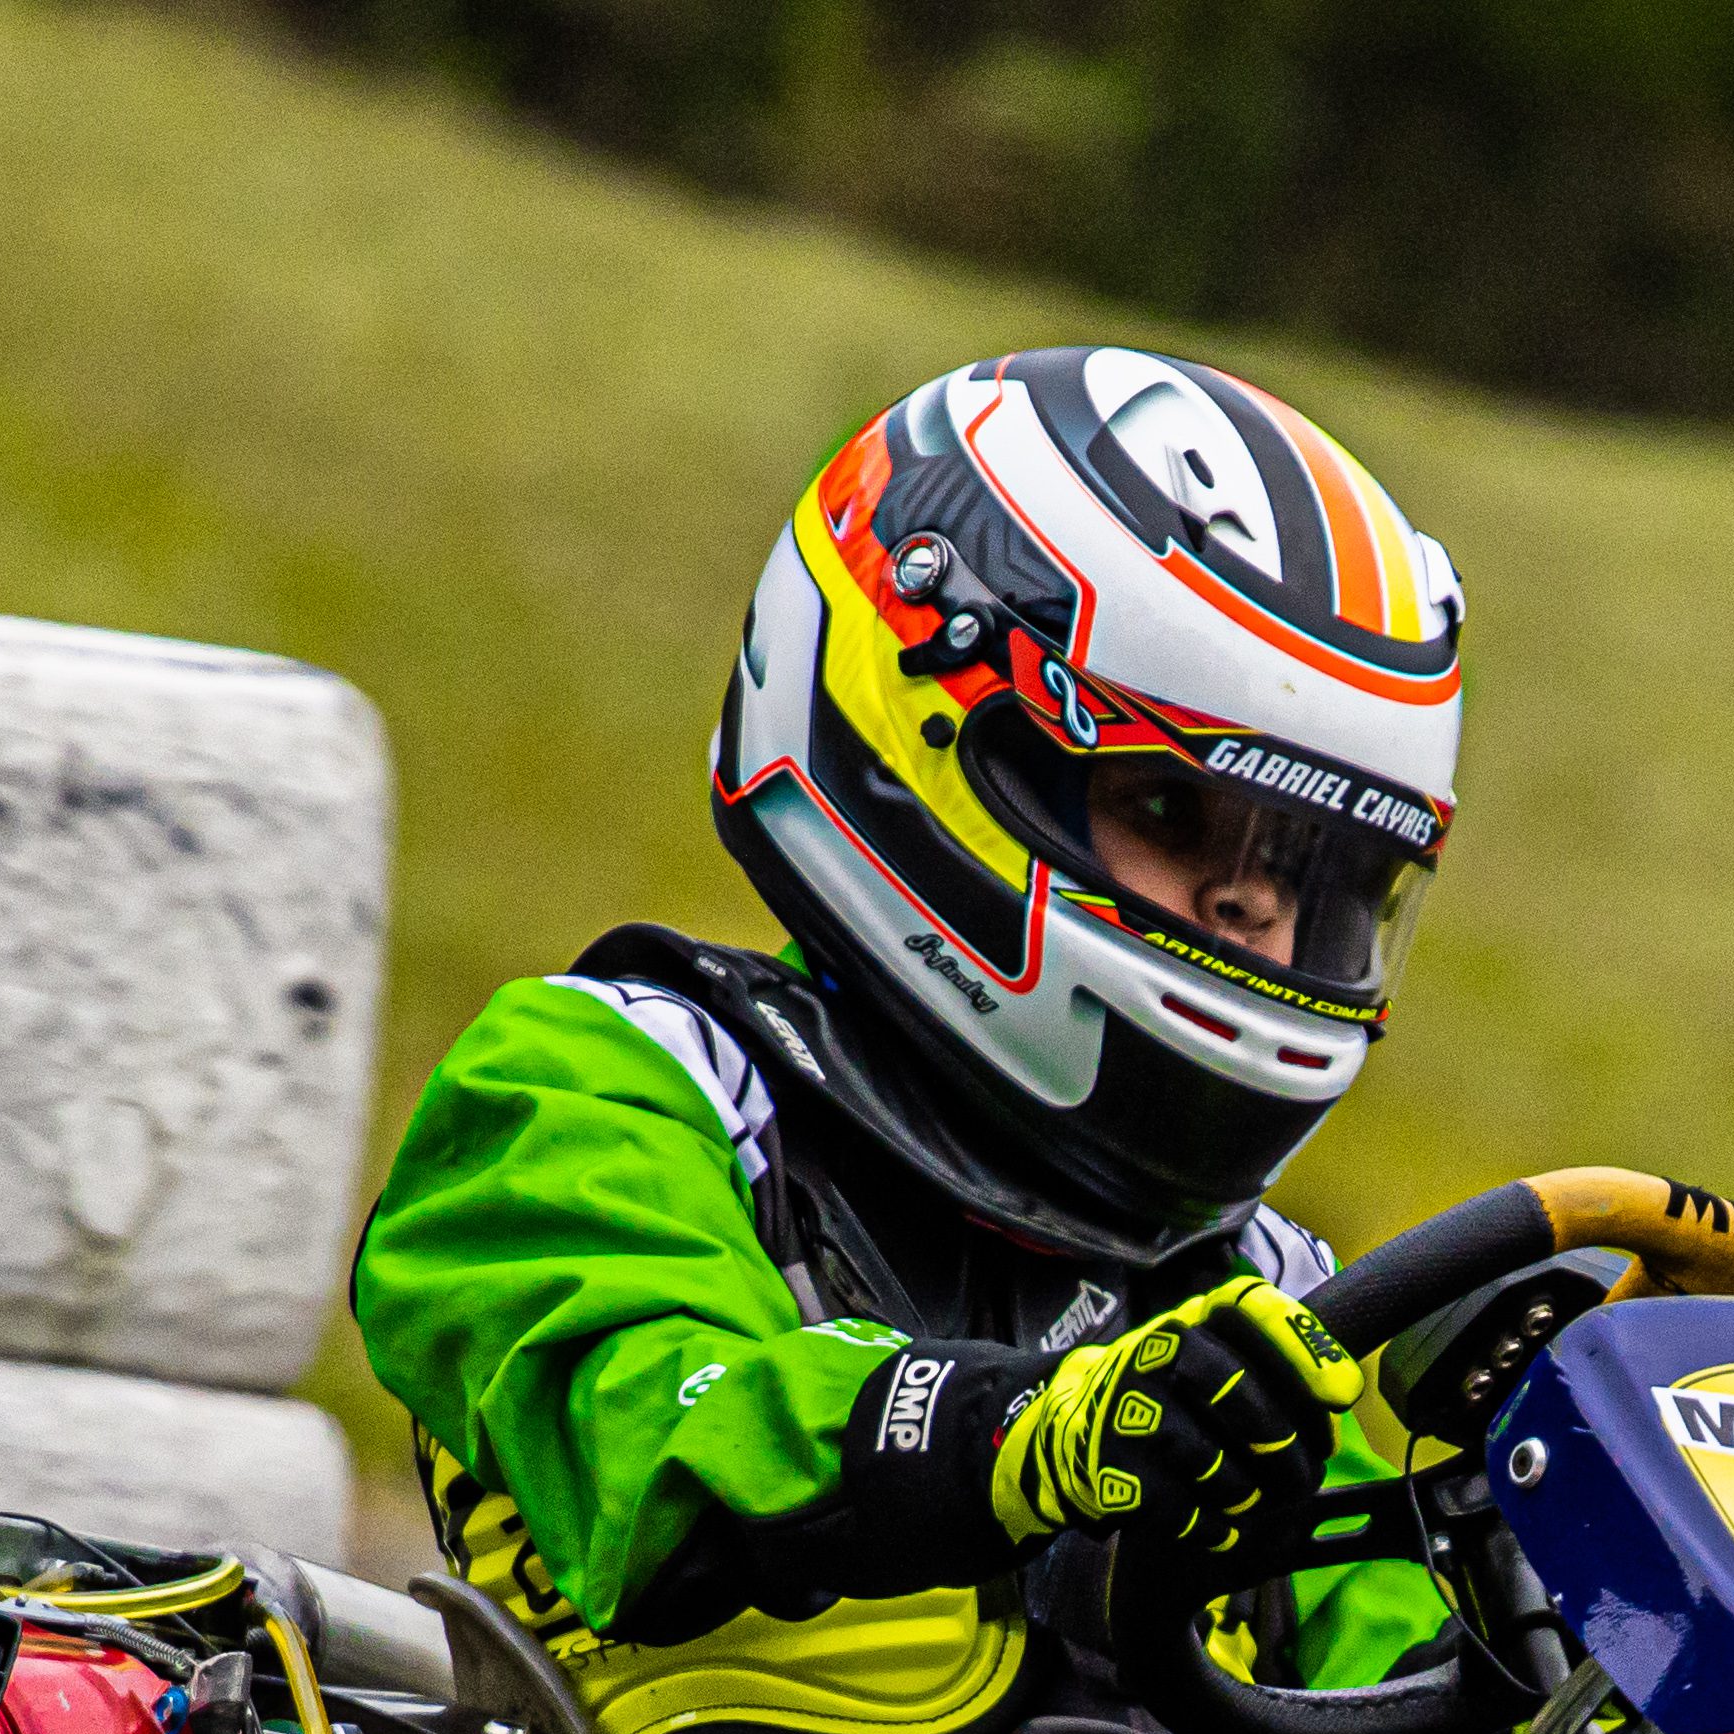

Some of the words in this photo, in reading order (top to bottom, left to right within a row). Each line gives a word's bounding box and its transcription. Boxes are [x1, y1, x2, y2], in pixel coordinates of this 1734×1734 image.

[1205, 738, 1352, 811] GABRIEL
[1352, 787, 1437, 847] CAYRES
[1293, 1312, 1343, 1364] OMP
[887, 1358, 942, 1450] OMP
